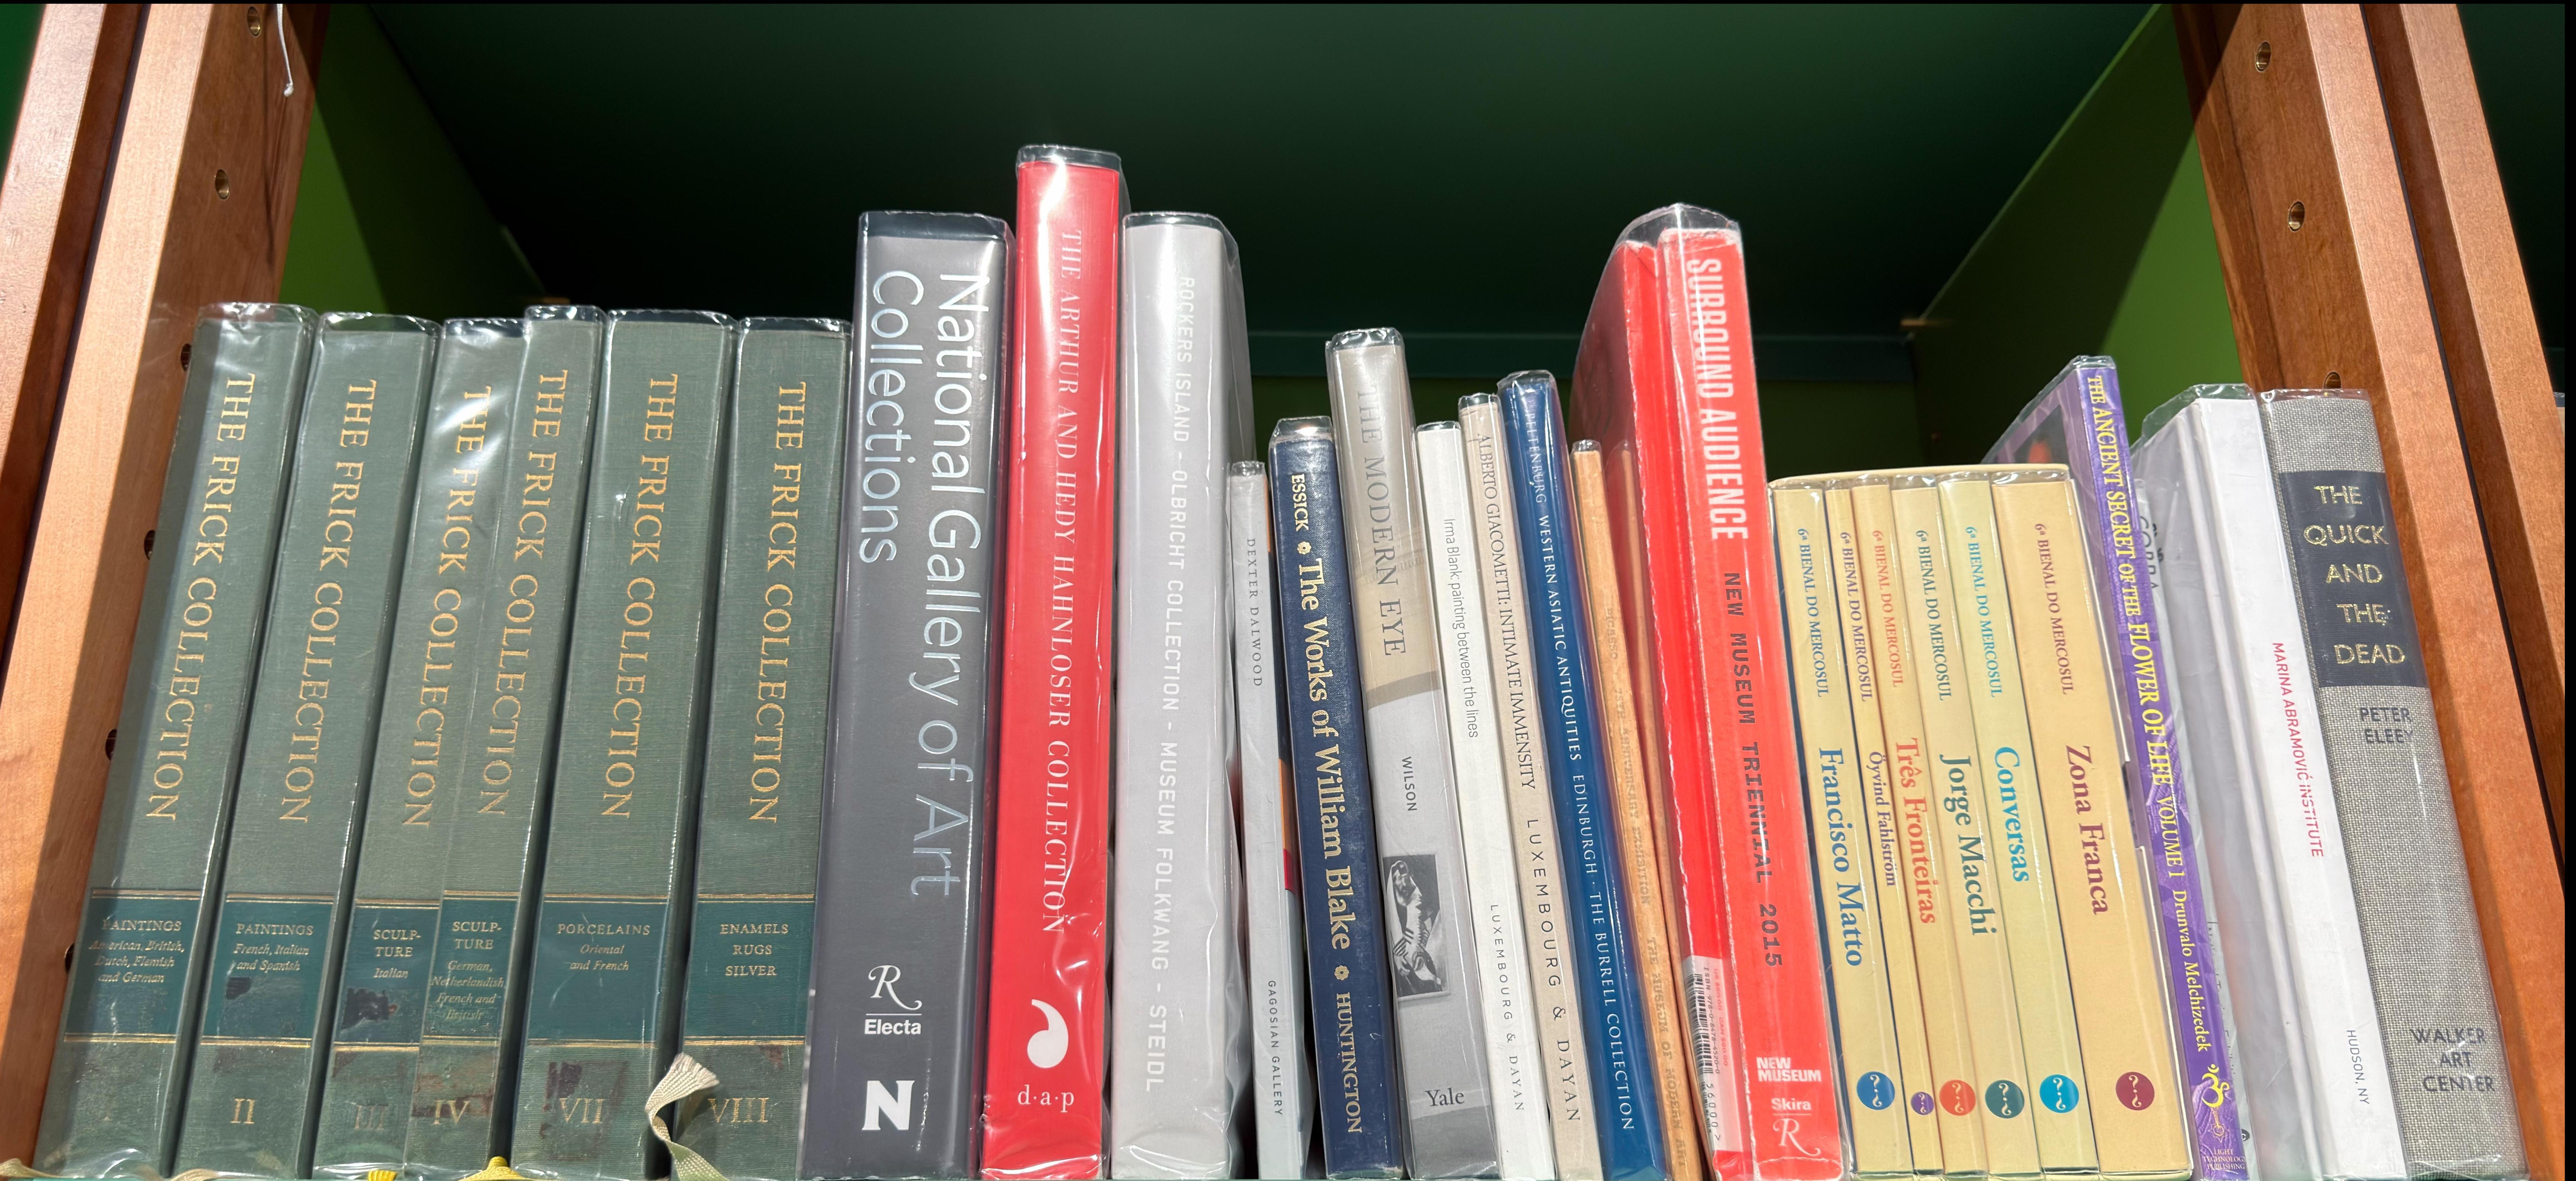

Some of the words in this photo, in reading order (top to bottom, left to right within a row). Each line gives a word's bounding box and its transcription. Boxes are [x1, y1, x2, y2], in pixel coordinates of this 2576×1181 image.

[1062, 230, 1082, 279] THE
[1059, 291, 1081, 393] ARTHUR
[1177, 276, 1195, 363] ROCKERS
[1686, 259, 1734, 398] SURROUND
[217, 373, 255, 441] THE
[340, 379, 377, 448] THE
[533, 369, 568, 438] THE
[931, 274, 990, 494] National
[1174, 372, 1192, 443] ISLAND
[1358, 385, 1382, 443] THE
[2088, 376, 2106, 405] THE
[859, 270, 924, 563] Collections
[1057, 406, 1077, 459] AND
[2093, 407, 2124, 487] ANCIENT
[1478, 433, 1497, 499] ALBERTO
[1525, 413, 1546, 503] PELTENBURG
[1701, 408, 1748, 539] AUDIENCE
[193, 456, 240, 564] FRICK
[320, 461, 362, 570] FRICK
[514, 452, 556, 562] FRICK
[1055, 472, 1077, 545] HEDY
[1169, 470, 1188, 569] OLBRICHT
[1292, 474, 1308, 531] ESSICK
[1365, 458, 1399, 585] MODERN
[2107, 490, 2136, 559] SECRET
[2314, 486, 2362, 505] THE
[1444, 519, 1456, 544] Irma
[1486, 504, 1511, 605] GIACOMETTI:
[1539, 515, 1557, 583] WESTERN
[2303, 525, 2388, 546] QUICK
[1247, 538, 1258, 599] DEXTER
[1299, 558, 1324, 611] The
[1447, 547, 1462, 580] Blank:
[1799, 545, 1815, 592] BIENAL
[1874, 545, 1890, 590] BIENAL
[2118, 563, 2137, 584] OF
[2326, 564, 2383, 584] AND
[910, 509, 982, 706] Gallery
[1448, 583, 1465, 629] painting
[1548, 590, 1566, 651] ASIATIC
[1724, 573, 1744, 616] NEW
[1806, 596, 1819, 617] DO
[1880, 593, 1893, 613] DO
[2122, 584, 2142, 617] THE
[2336, 603, 2385, 624] THE
[1049, 556, 1075, 726] HAHNLOSER
[1162, 580, 1183, 710] COLLECTION
[1251, 608, 1262, 686] DALWOOD
[1380, 599, 1406, 656] EYE
[1458, 632, 1471, 683] between
[1500, 609, 1523, 688] INTIMATE
[1884, 617, 1903, 687] MERCOSUL
[2334, 644, 2405, 665] DEAD
[1304, 617, 1333, 701] Works
[1731, 633, 1755, 724] MUSEUM
[1809, 621, 1829, 697] MERCOSUL
[2128, 622, 2159, 706] FLOWER
[146, 577, 217, 821] COLLECTION
[279, 582, 343, 822] COLLECTION
[478, 575, 538, 815] COLLECTION
[1311, 709, 1339, 737] of
[1464, 686, 1477, 706] the
[1466, 710, 1479, 738] lines
[1557, 656, 1582, 760] ANTIQUITIES
[2142, 709, 2168, 739] OF
[2360, 707, 2412, 723] PETER
[917, 720, 973, 782] of
[1510, 691, 1536, 790] IMMENSITY
[1896, 738, 1923, 788] Três
[2147, 741, 2173, 785] LIFE
[2273, 643, 2292, 696] MARINA
[2283, 699, 2313, 780] ABRAMOVIĆ
[2299, 784, 2324, 857] INSTITUTE
[2364, 729, 2413, 744] ELEEY
[1158, 742, 1177, 835] MUSEUM
[1315, 744, 1346, 859] William
[1402, 756, 1417, 811] WILSON
[1867, 751, 1890, 806] Öyvind
[2066, 745, 2093, 814] Zona
[1042, 741, 1070, 933] COLLECTION
[1573, 776, 1597, 873] EDINBURGH
[1742, 742, 1772, 883] TRIENNIAL
[1995, 747, 2029, 882] Conversas
[2157, 796, 2183, 867] VOLUME
[910, 794, 969, 896] Art
[1819, 748, 1853, 873] Francisco
[1837, 881, 1864, 966] Matto
[1903, 797, 1938, 924] Fronteiras
[1939, 754, 1971, 826] Jorge
[1958, 834, 1997, 936] Macchi
[2079, 823, 2109, 915] Franca
[102, 920, 181, 931] PAINTINGS
[236, 923, 313, 935] PAINTINGS
[452, 921, 502, 932] SCULP-
[557, 924, 650, 935] PORCELAINS
[720, 924, 788, 935] ENAMELS
[1152, 848, 1172, 971] FOLKWANG
[1326, 866, 1356, 949] Blake
[1527, 820, 1561, 986] LUXEMBOURG
[1590, 892, 1605, 925] THE
[2173, 890, 2196, 957] Drunvalo
[233, 943, 272, 956] French,
[274, 944, 309, 955] Italian
[374, 930, 421, 940] SCULP-
[376, 947, 413, 957] TURE
[455, 939, 493, 949] TURE
[570, 960, 591, 970] and
[593, 960, 629, 970] French
[580, 944, 625, 954] Oriental
[733, 945, 772, 956] RUGS
[1760, 904, 1783, 967] 2015
[98, 972, 120, 982] and
[123, 972, 164, 983] German
[237, 959, 258, 970] and
[259, 960, 300, 973] Spanish
[374, 968, 408, 978] Italian
[725, 965, 776, 977] SILVER
[1595, 933, 1616, 1006] BURRELL
[865, 1018, 922, 1035] Electa
[1268, 981, 1279, 1048] GAGOSIAN
[2184, 961, 2213, 1052] Melchizedek
[2410, 1028, 2486, 1044] WALKER
[1146, 1005, 1168, 1092] STEIDL
[1337, 992, 1362, 1132] HUNTINGTON
[1607, 1013, 1635, 1129] COLLECTION
[1756, 1057, 1791, 1069] NEW
[1758, 1070, 1821, 1081] MUSEUM
[2347, 1030, 2365, 1084] HUDSON,
[2357, 1088, 2369, 1104] NY
[2440, 1052, 2472, 1067] ART
[559, 1098, 605, 1123] VII
[707, 1098, 769, 1123] VIII
[1272, 1056, 1283, 1115] GALLERY
[1425, 1088, 1465, 1106] Yale
[1557, 1040, 1580, 1120] DAYAN
[1772, 1098, 1811, 1111] Skira
[2423, 1076, 2495, 1092] CENTER
[230, 1099, 256, 1124] II
[433, 1100, 471, 1123] IV
